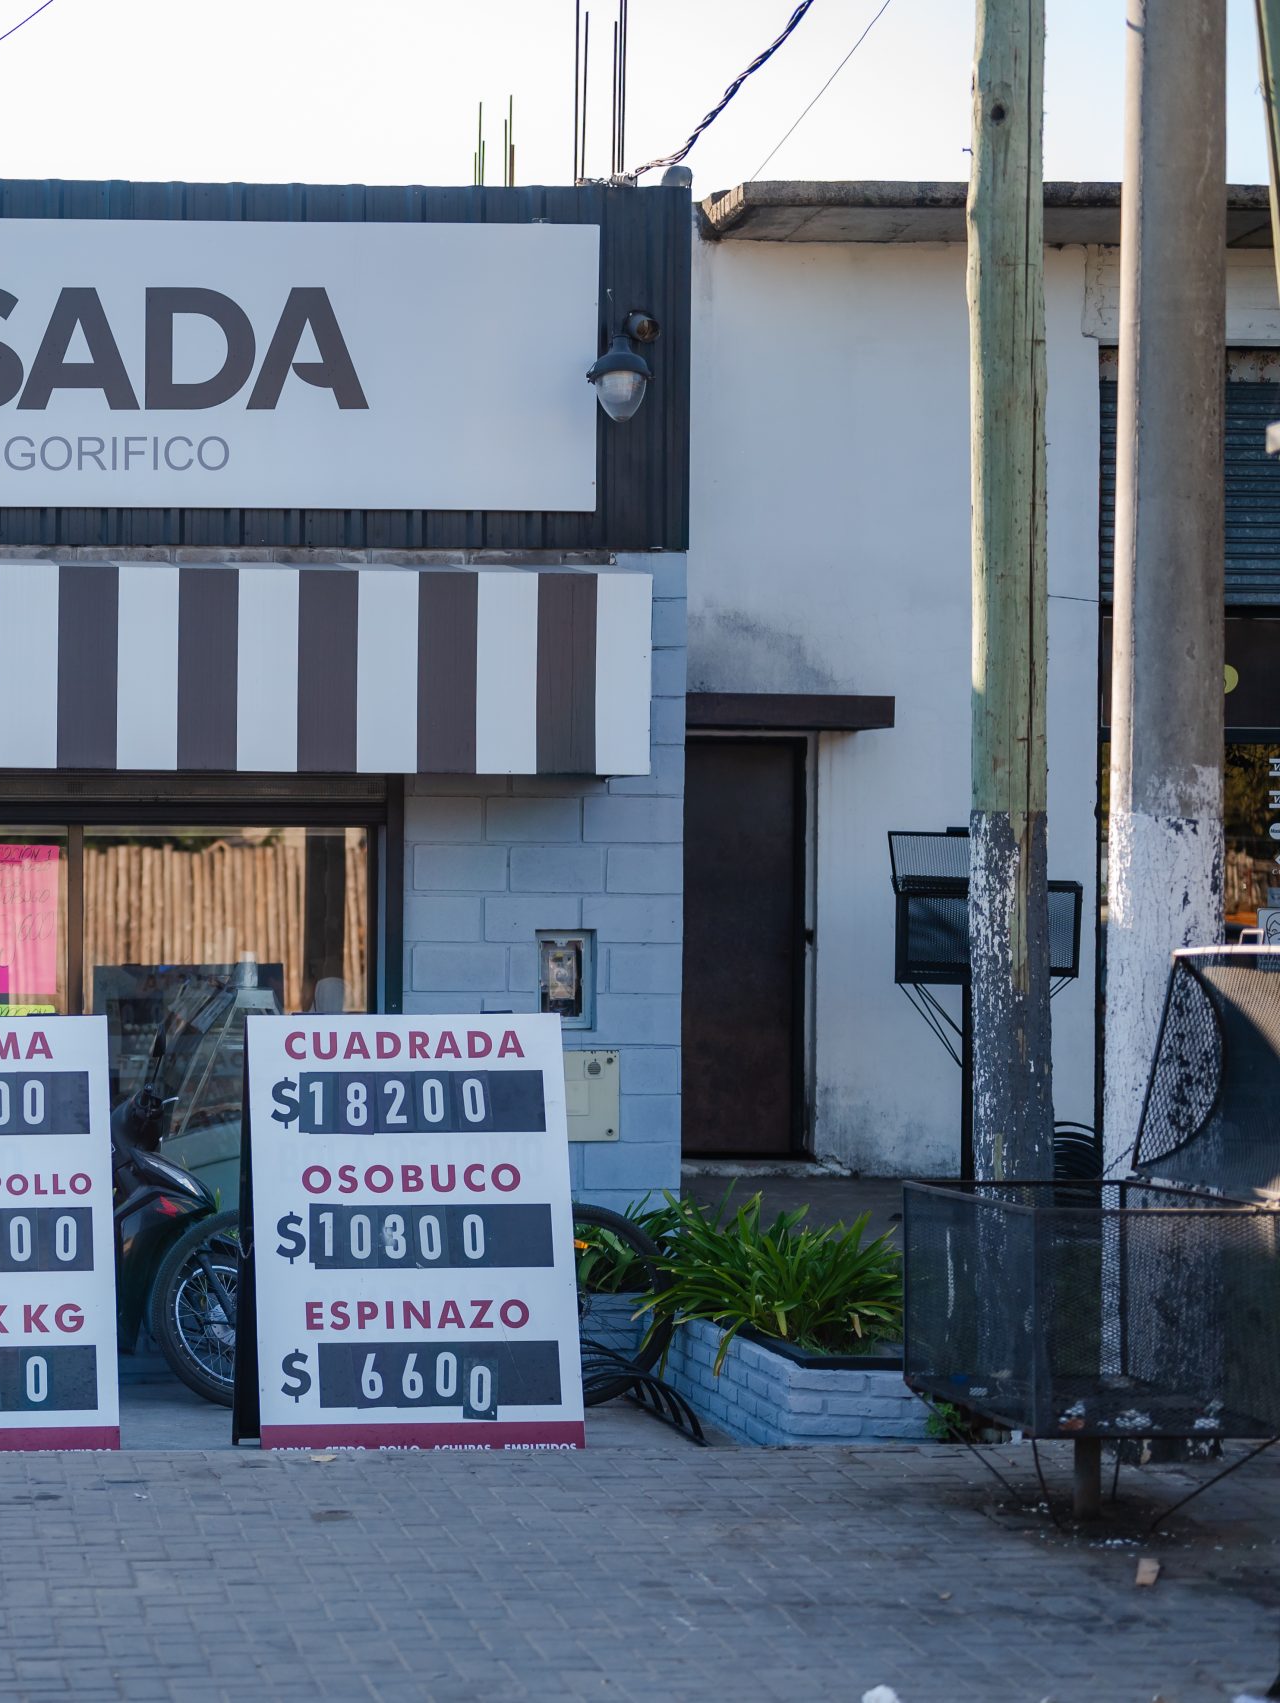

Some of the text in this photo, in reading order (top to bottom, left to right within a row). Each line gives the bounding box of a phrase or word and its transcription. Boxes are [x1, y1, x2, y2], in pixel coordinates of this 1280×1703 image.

[284, 1030, 525, 1060] CUADRADA
[301, 1163, 521, 1194] OSOBUCO
[23, 1303, 85, 1333] KG
[305, 1299, 530, 1331] ESPINAZO
